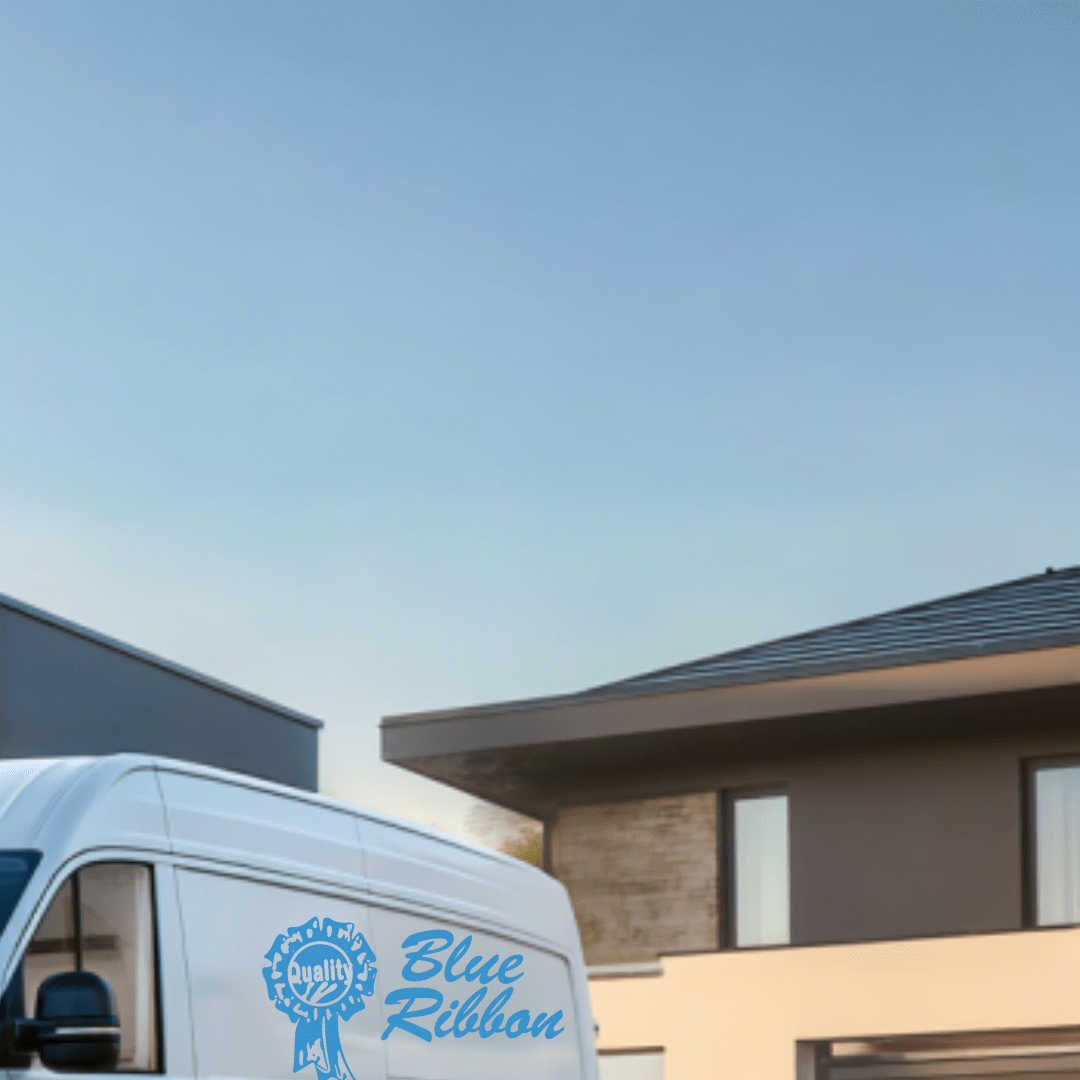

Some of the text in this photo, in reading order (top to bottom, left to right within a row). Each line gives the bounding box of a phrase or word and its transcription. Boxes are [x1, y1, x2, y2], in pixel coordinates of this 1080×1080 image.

[290, 958, 350, 985] Quality
[401, 929, 525, 985] Blue
[380, 986, 565, 1043] Ribbon
